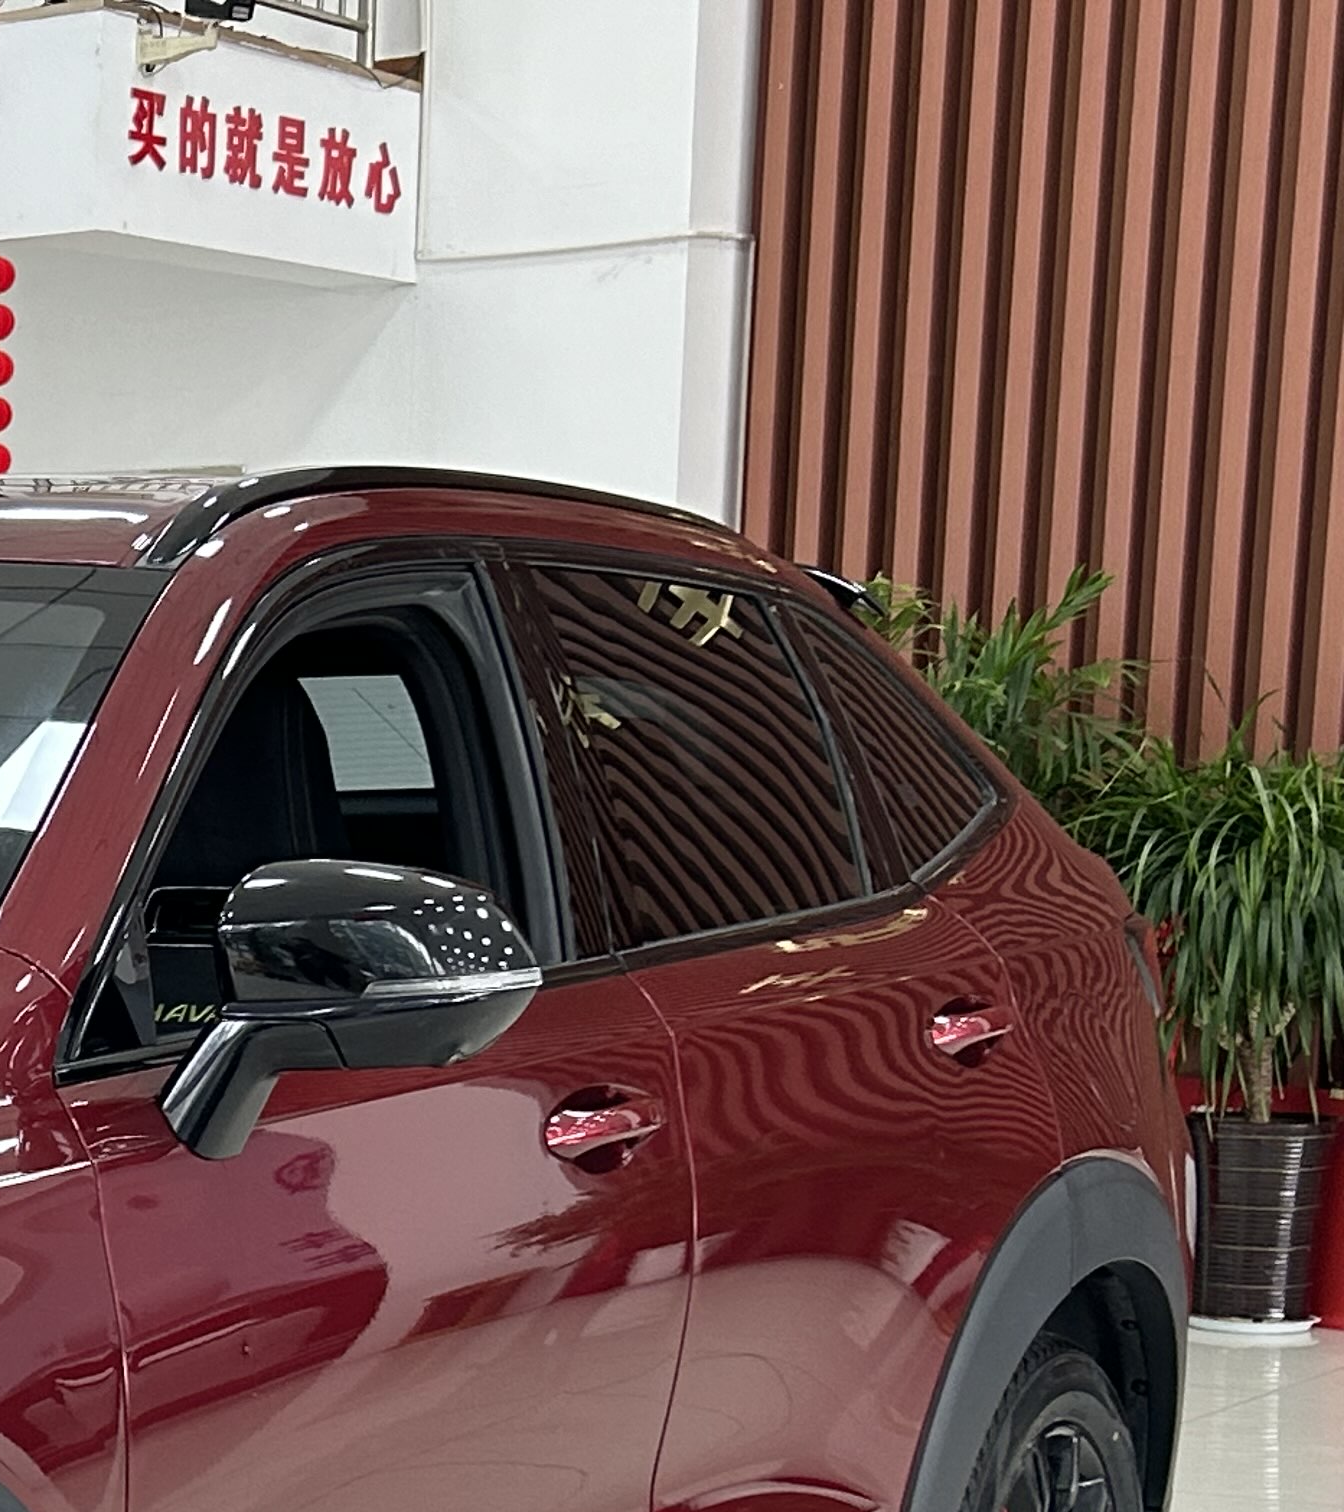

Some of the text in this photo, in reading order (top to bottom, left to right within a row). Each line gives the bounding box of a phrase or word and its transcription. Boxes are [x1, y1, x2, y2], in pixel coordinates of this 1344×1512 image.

[128, 87, 402, 214] 买的就是放心
